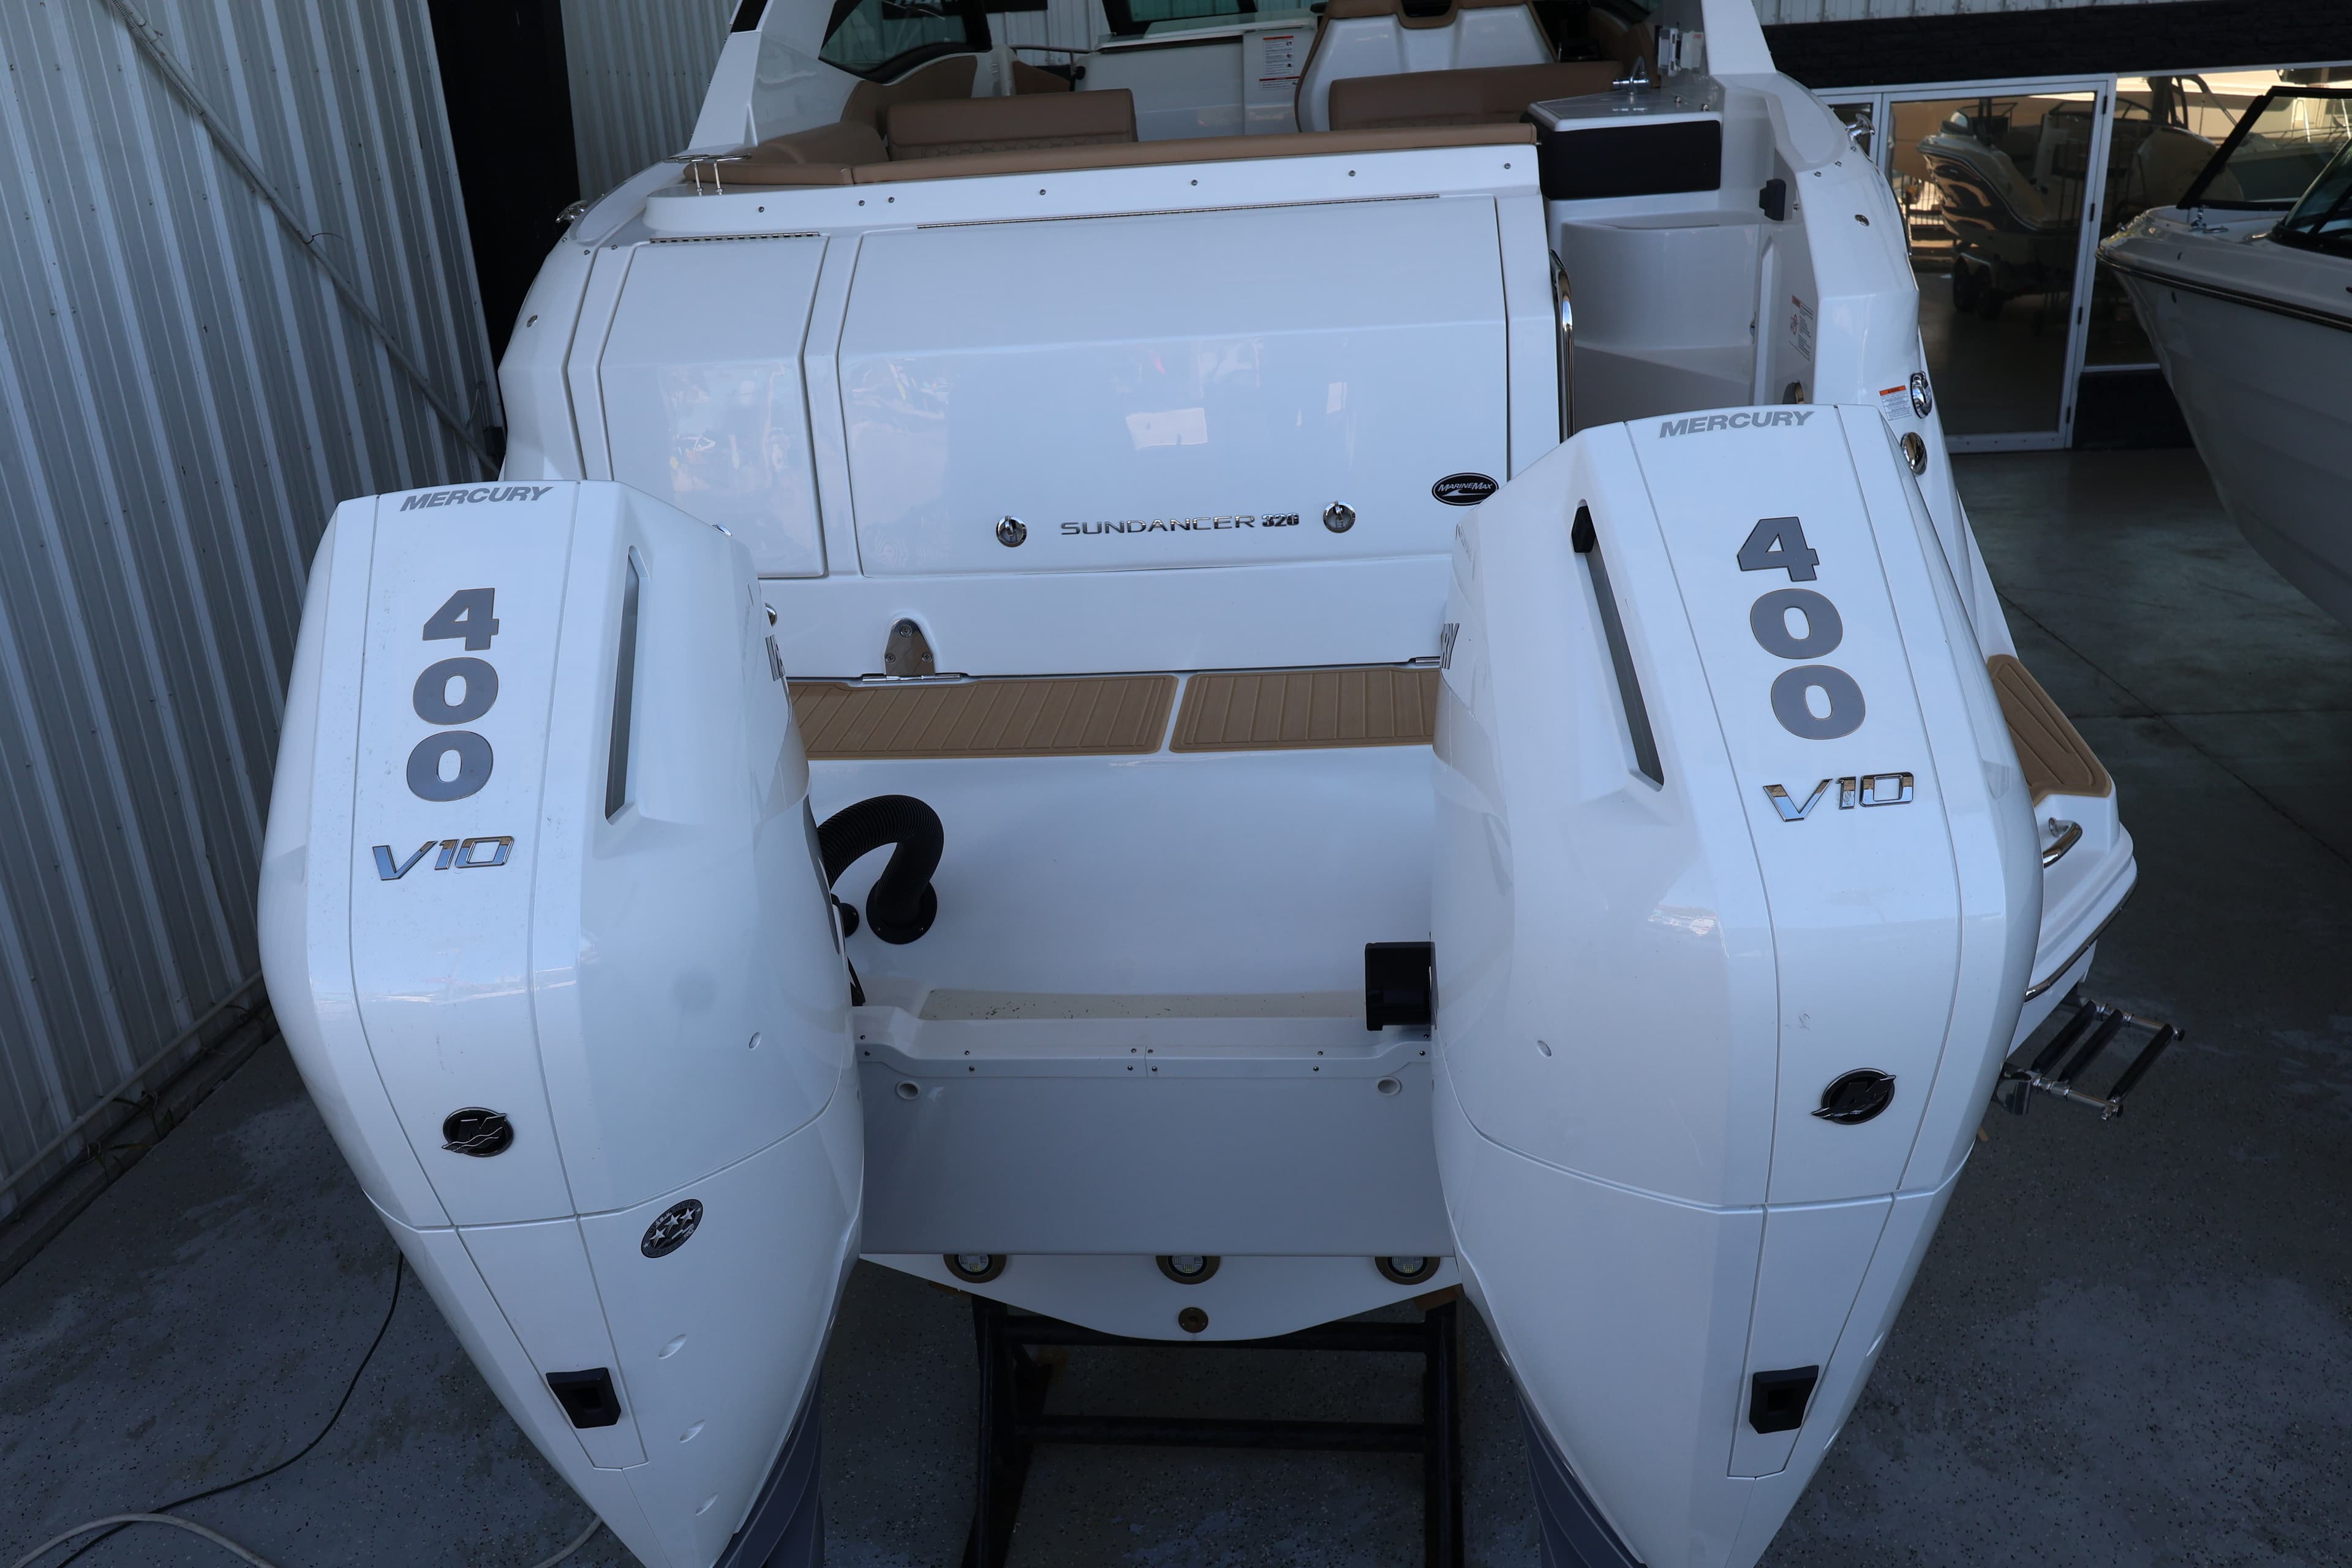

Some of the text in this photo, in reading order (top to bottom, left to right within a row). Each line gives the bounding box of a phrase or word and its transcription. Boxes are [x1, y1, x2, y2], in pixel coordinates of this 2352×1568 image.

[1659, 411, 1815, 438] MERCURY
[400, 486, 554, 512] MERCURY
[1060, 512, 1300, 535] SUNDANCER 320
[1736, 516, 1866, 740] 400
[406, 587, 499, 802] 400
[1763, 772, 1915, 822] V10
[372, 835, 514, 881] V10
